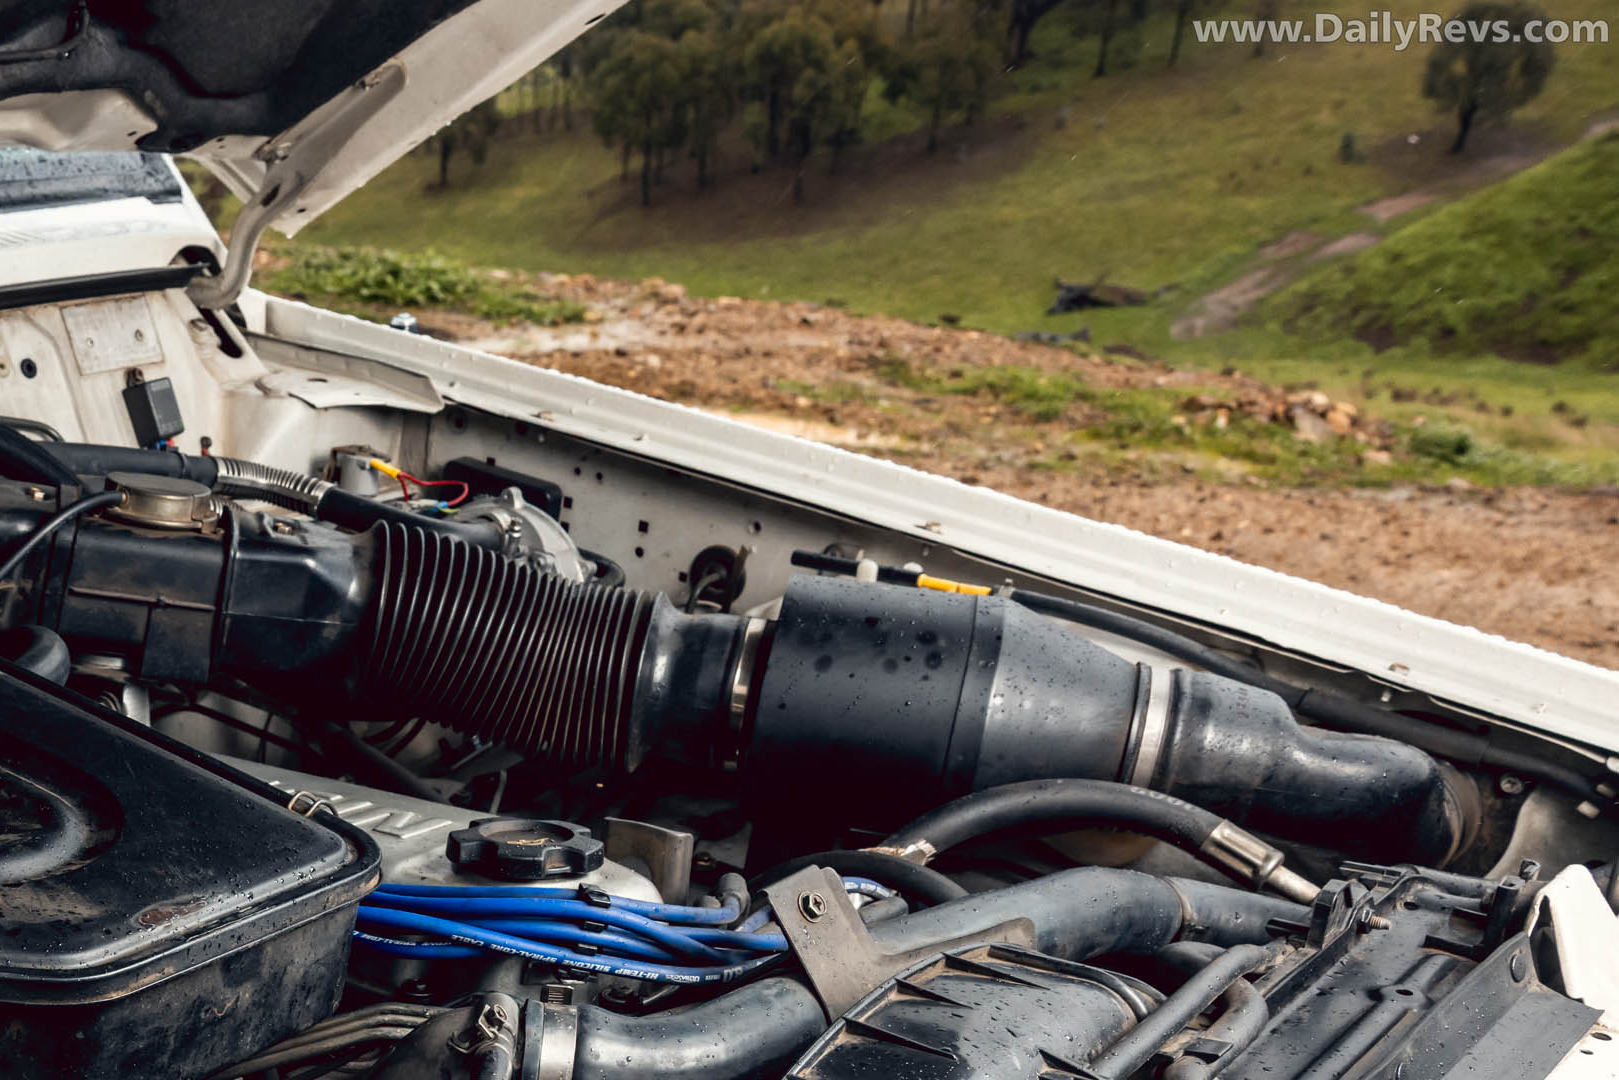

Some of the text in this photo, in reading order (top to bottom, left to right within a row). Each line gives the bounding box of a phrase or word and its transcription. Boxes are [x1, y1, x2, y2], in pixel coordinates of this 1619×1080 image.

[451, 934, 485, 946] CABLE
[490, 943, 558, 963] SPIRAL-CORE
[562, 958, 612, 972] SILICONE
[614, 967, 660, 980] HI-TEMP
